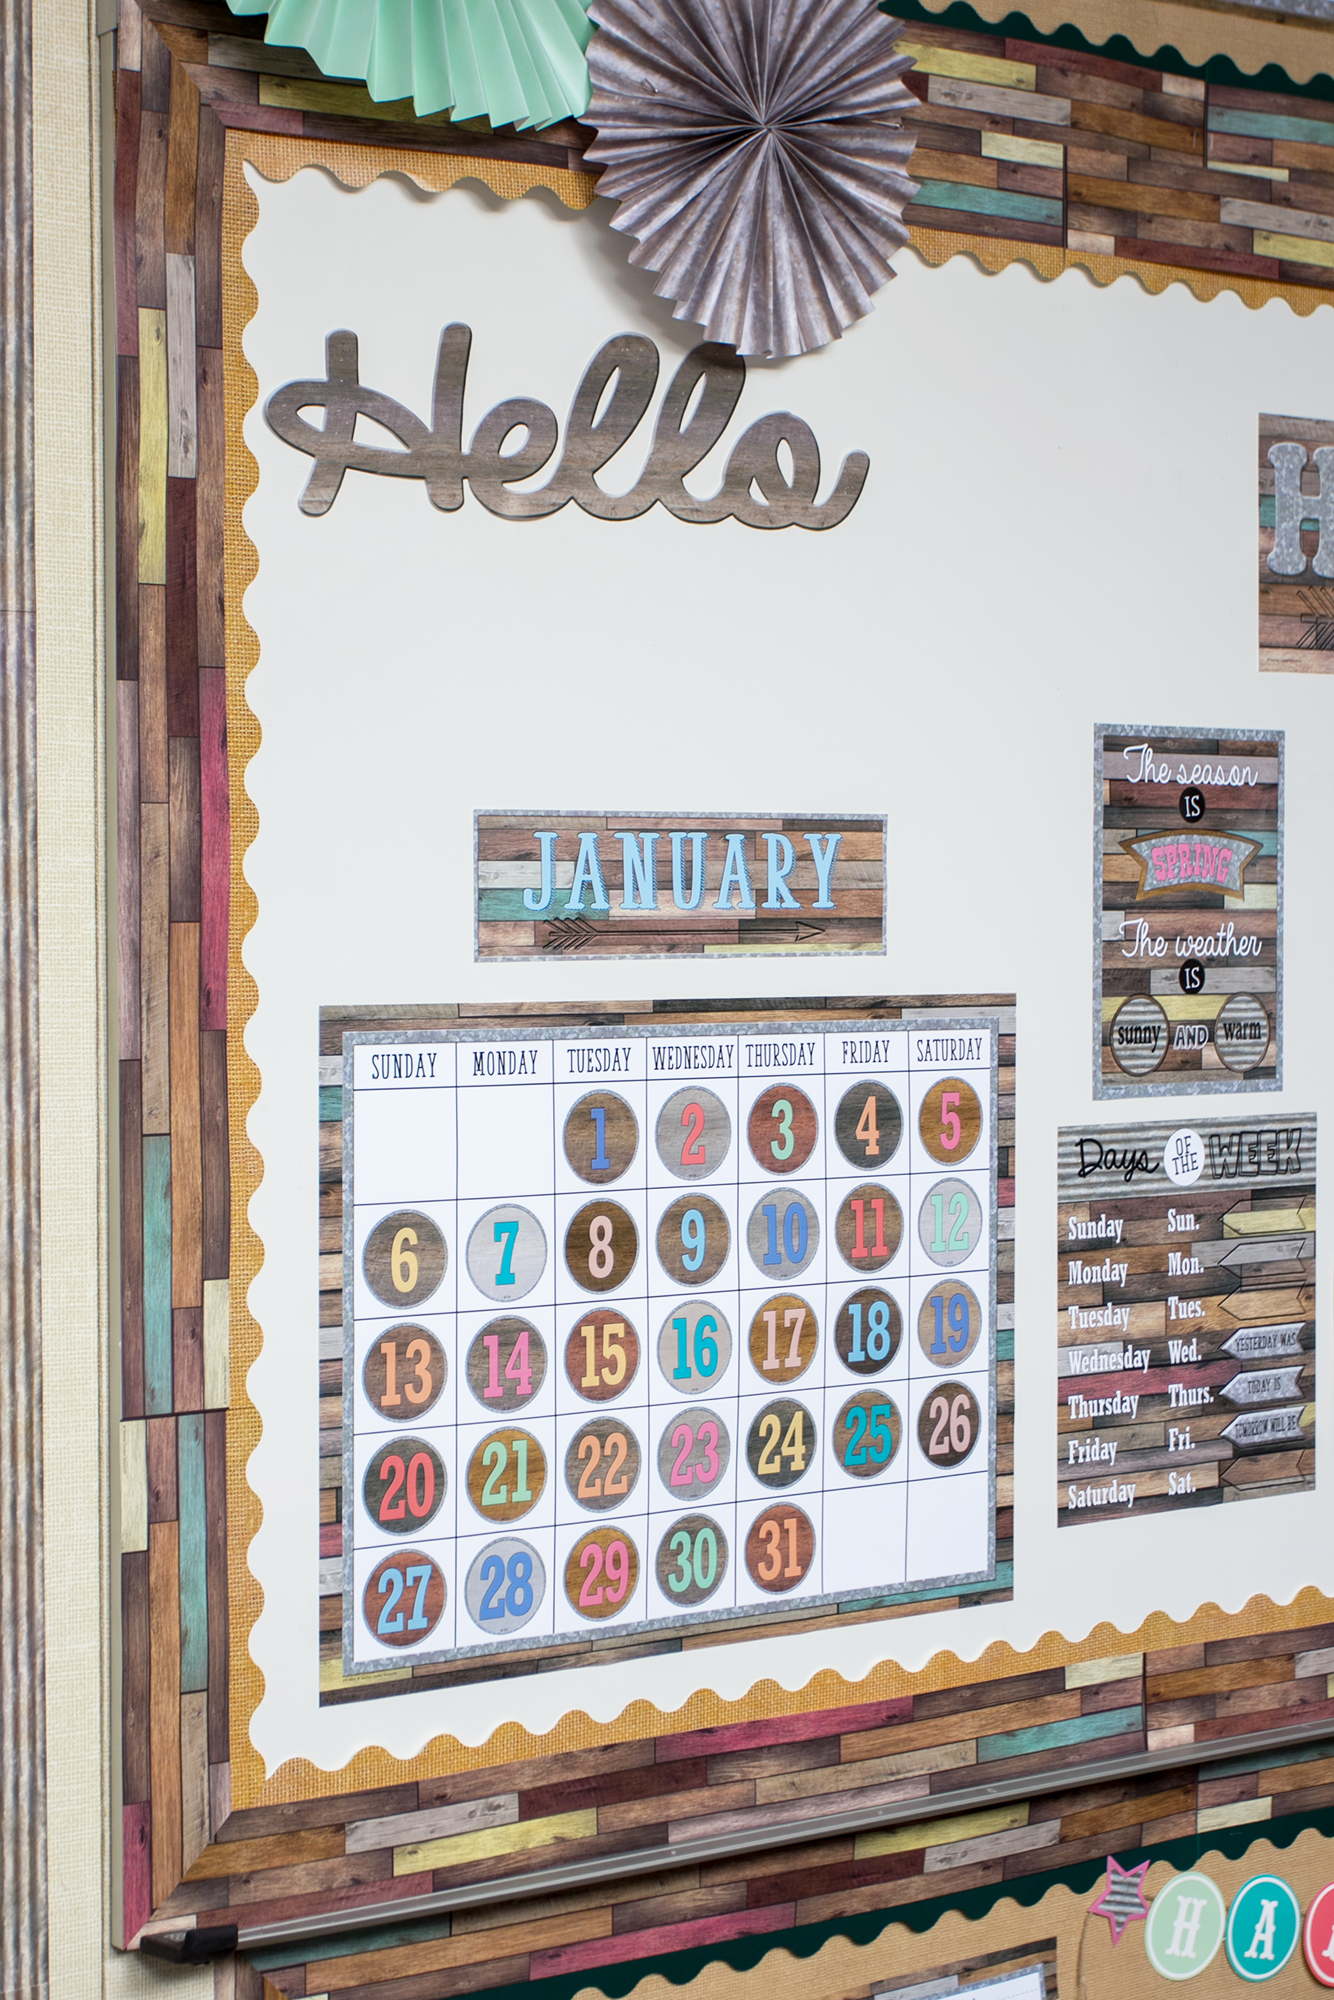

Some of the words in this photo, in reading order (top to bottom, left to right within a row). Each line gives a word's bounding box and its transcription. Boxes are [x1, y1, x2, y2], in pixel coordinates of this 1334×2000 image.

[264, 321, 871, 531] Hello
[1267, 442, 1334, 578] H
[1123, 743, 1172, 786] The
[1176, 762, 1259, 787] season
[1184, 795, 1201, 818] IS
[522, 831, 843, 912] JANUARY
[1151, 842, 1233, 884] SPRING
[1118, 917, 1169, 958] The
[1175, 921, 1263, 958] weather
[1184, 967, 1201, 990] IS
[1117, 1024, 1161, 1053] sunny
[1173, 1025, 1209, 1050] AND
[1222, 1020, 1262, 1042] warm
[371, 1052, 438, 1080] SUNDAY
[472, 1049, 539, 1077] MONDAY
[566, 1047, 632, 1074] TUESDAY
[652, 1044, 735, 1071] WEDNESDAY
[745, 1042, 816, 1068] THURSDAY
[841, 1039, 890, 1065] FRIDAY
[916, 1037, 983, 1063] SATURDAY
[590, 1107, 611, 1170] 1
[680, 1102, 706, 1166] 2
[770, 1098, 795, 1161] 3
[855, 1095, 880, 1156] 4
[939, 1091, 962, 1150] 5
[1175, 1136, 1192, 1156] OF
[1075, 1138, 1159, 1182] Days
[1171, 1152, 1199, 1176] THE
[1209, 1128, 1301, 1179] WEEK
[390, 1226, 419, 1294] 6
[493, 1220, 519, 1286] 7
[588, 1215, 614, 1279] 8
[680, 1208, 706, 1272] 9
[762, 1201, 809, 1265] 10
[850, 1197, 889, 1259] 11
[930, 1191, 970, 1254] 12
[1068, 1214, 1124, 1243] Sunday
[1167, 1208, 1200, 1233] Sun.
[1068, 1258, 1128, 1287] Monday
[1167, 1251, 1204, 1277] Mon.
[1068, 1302, 1130, 1331] Tuesday
[1167, 1296, 1206, 1321] Tues.
[379, 1338, 433, 1407] 13
[482, 1330, 533, 1399] 14
[580, 1322, 627, 1388] 15
[672, 1314, 719, 1380] 16
[762, 1307, 807, 1371] 17
[847, 1299, 891, 1364] 18
[930, 1292, 970, 1355] 19
[1068, 1344, 1151, 1375] Wednesday
[1168, 1338, 1202, 1365] Wed.
[1235, 1333, 1278, 1352] YESTERDAY
[1280, 1332, 1296, 1347] WAS
[1068, 1390, 1139, 1421] Thursday
[1168, 1383, 1214, 1409] Thurs.
[1247, 1378, 1271, 1394] TODAY
[1273, 1376, 1281, 1391] IS
[1270, 1416, 1286, 1433] WILL
[1287, 1415, 1296, 1430] BE
[378, 1451, 436, 1522] 20
[481, 1438, 532, 1507] 21
[577, 1431, 629, 1500] 22
[669, 1420, 720, 1487] 23
[757, 1410, 806, 1476] 24
[844, 1403, 893, 1467] 25
[928, 1392, 971, 1456] 26
[1068, 1436, 1118, 1466] Friday
[1168, 1427, 1195, 1452] Fri.
[1068, 1481, 1136, 1510] Saturday
[1168, 1472, 1196, 1496] Sat.
[376, 1563, 433, 1636] 27
[479, 1551, 534, 1622] 28
[578, 1539, 630, 1608] 29
[667, 1526, 718, 1594] 30
[757, 1517, 802, 1582] 31
